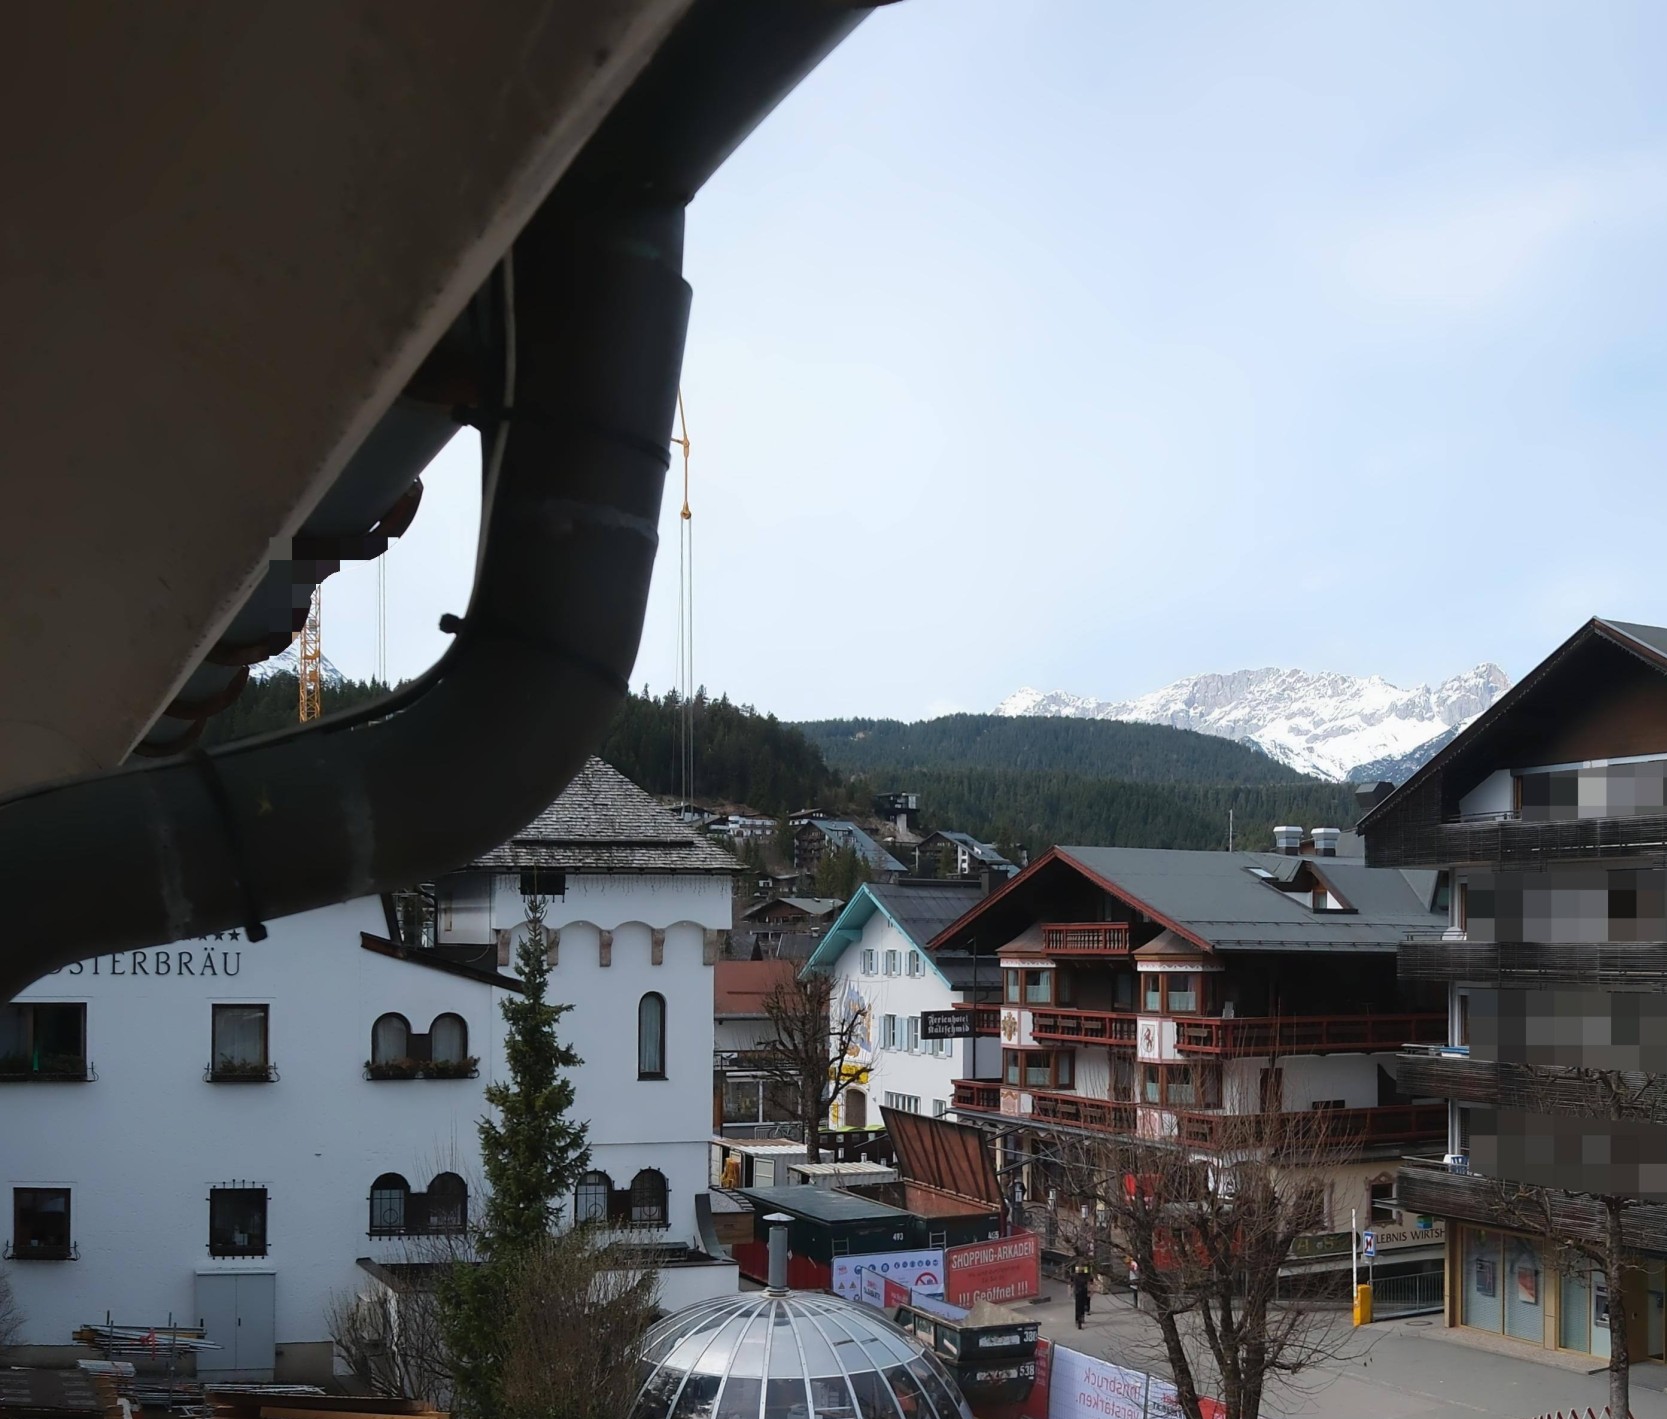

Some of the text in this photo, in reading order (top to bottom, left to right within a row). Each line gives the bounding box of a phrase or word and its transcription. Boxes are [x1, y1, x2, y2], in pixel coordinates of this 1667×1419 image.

[50, 948, 241, 975] STERBRÄU
[951, 1242, 1034, 1269] SHOPPING-ARKADEN
[973, 1284, 1015, 1303] Geöffnet
